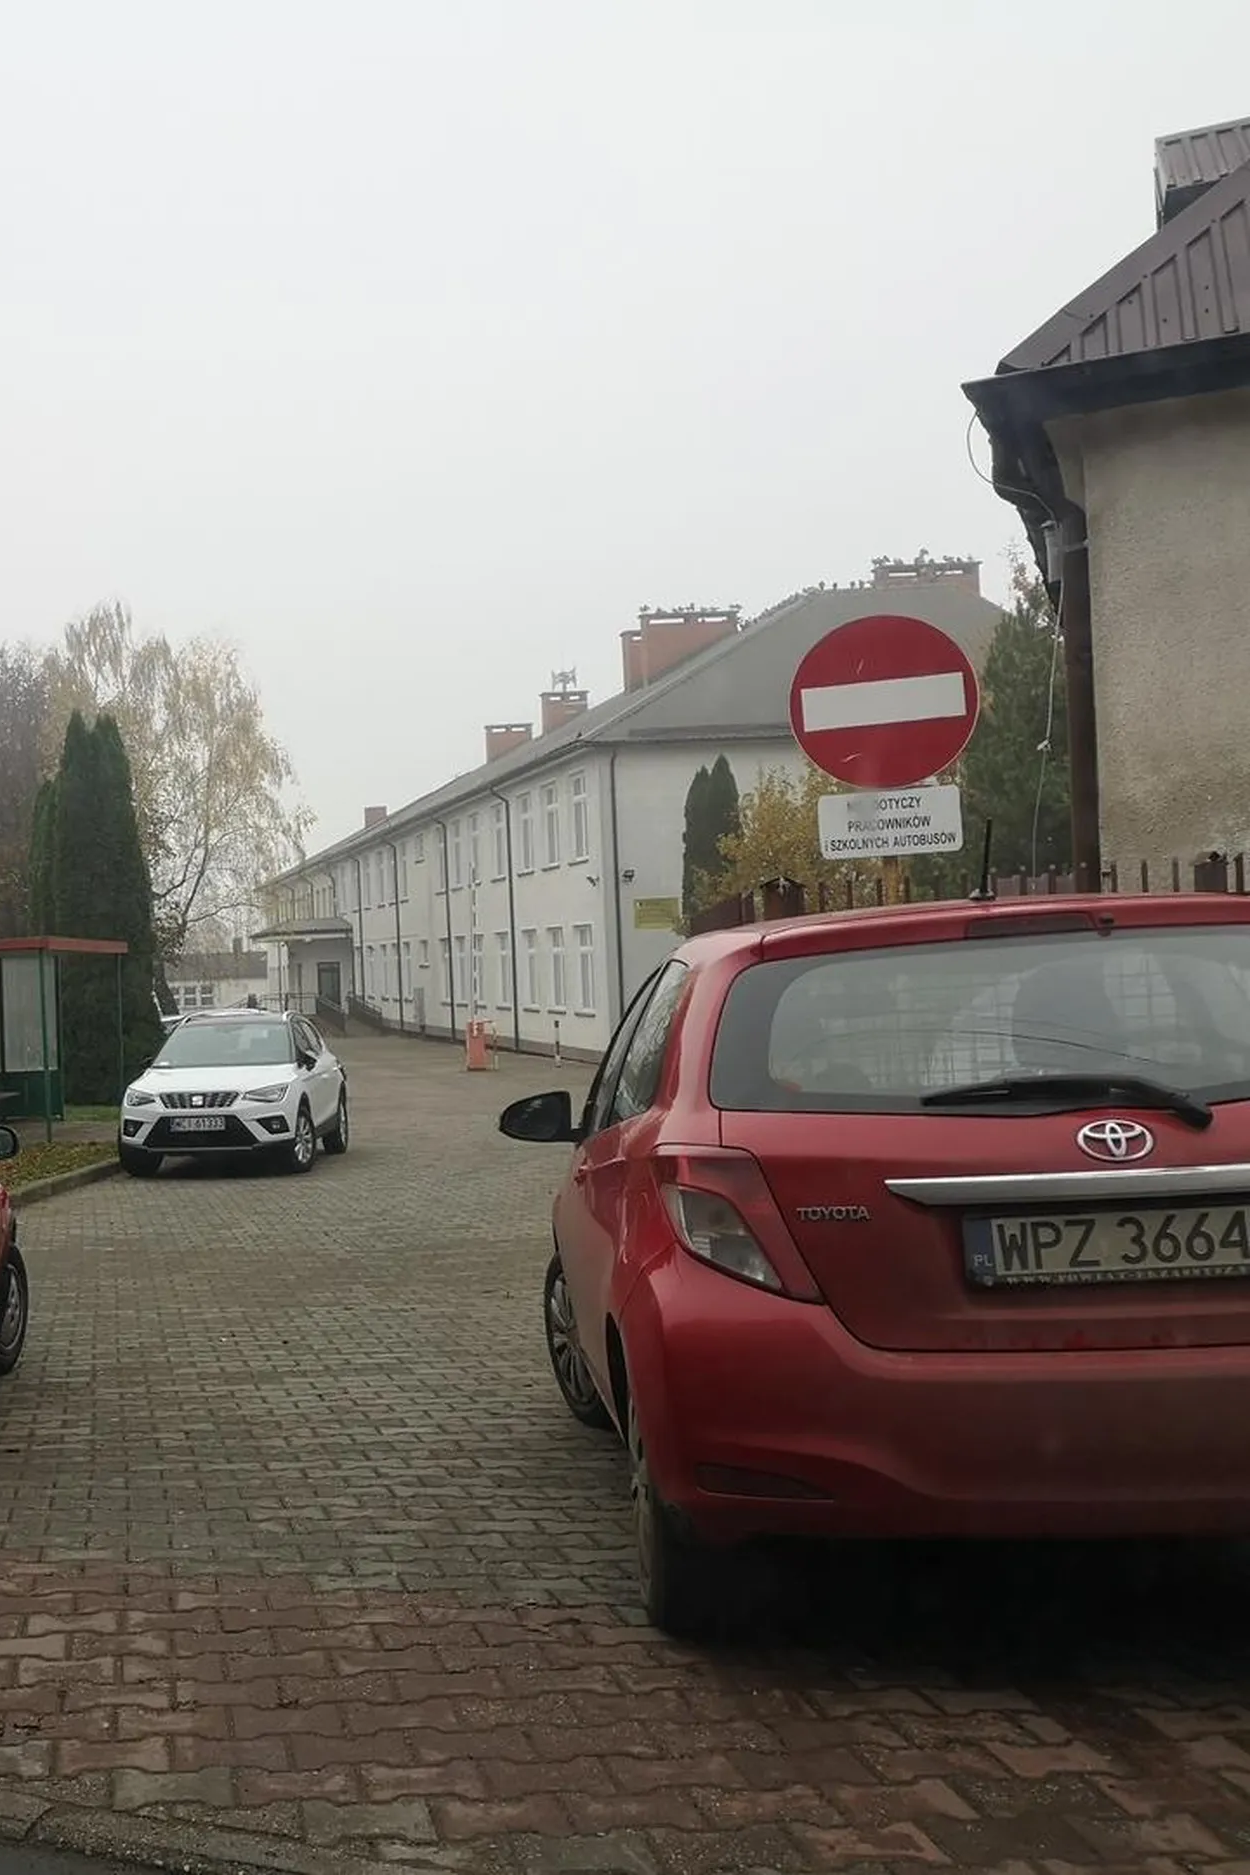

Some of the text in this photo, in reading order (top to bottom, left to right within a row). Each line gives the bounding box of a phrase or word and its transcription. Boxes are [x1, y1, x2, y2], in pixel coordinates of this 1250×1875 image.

[831, 837, 890, 852] SZKOLNYCH
[893, 831, 957, 847] AUTOBUSÓW
[796, 1205, 871, 1222] TOYOTA
[973, 1255, 993, 1267] PL
[996, 1218, 1102, 1271] WPZ
